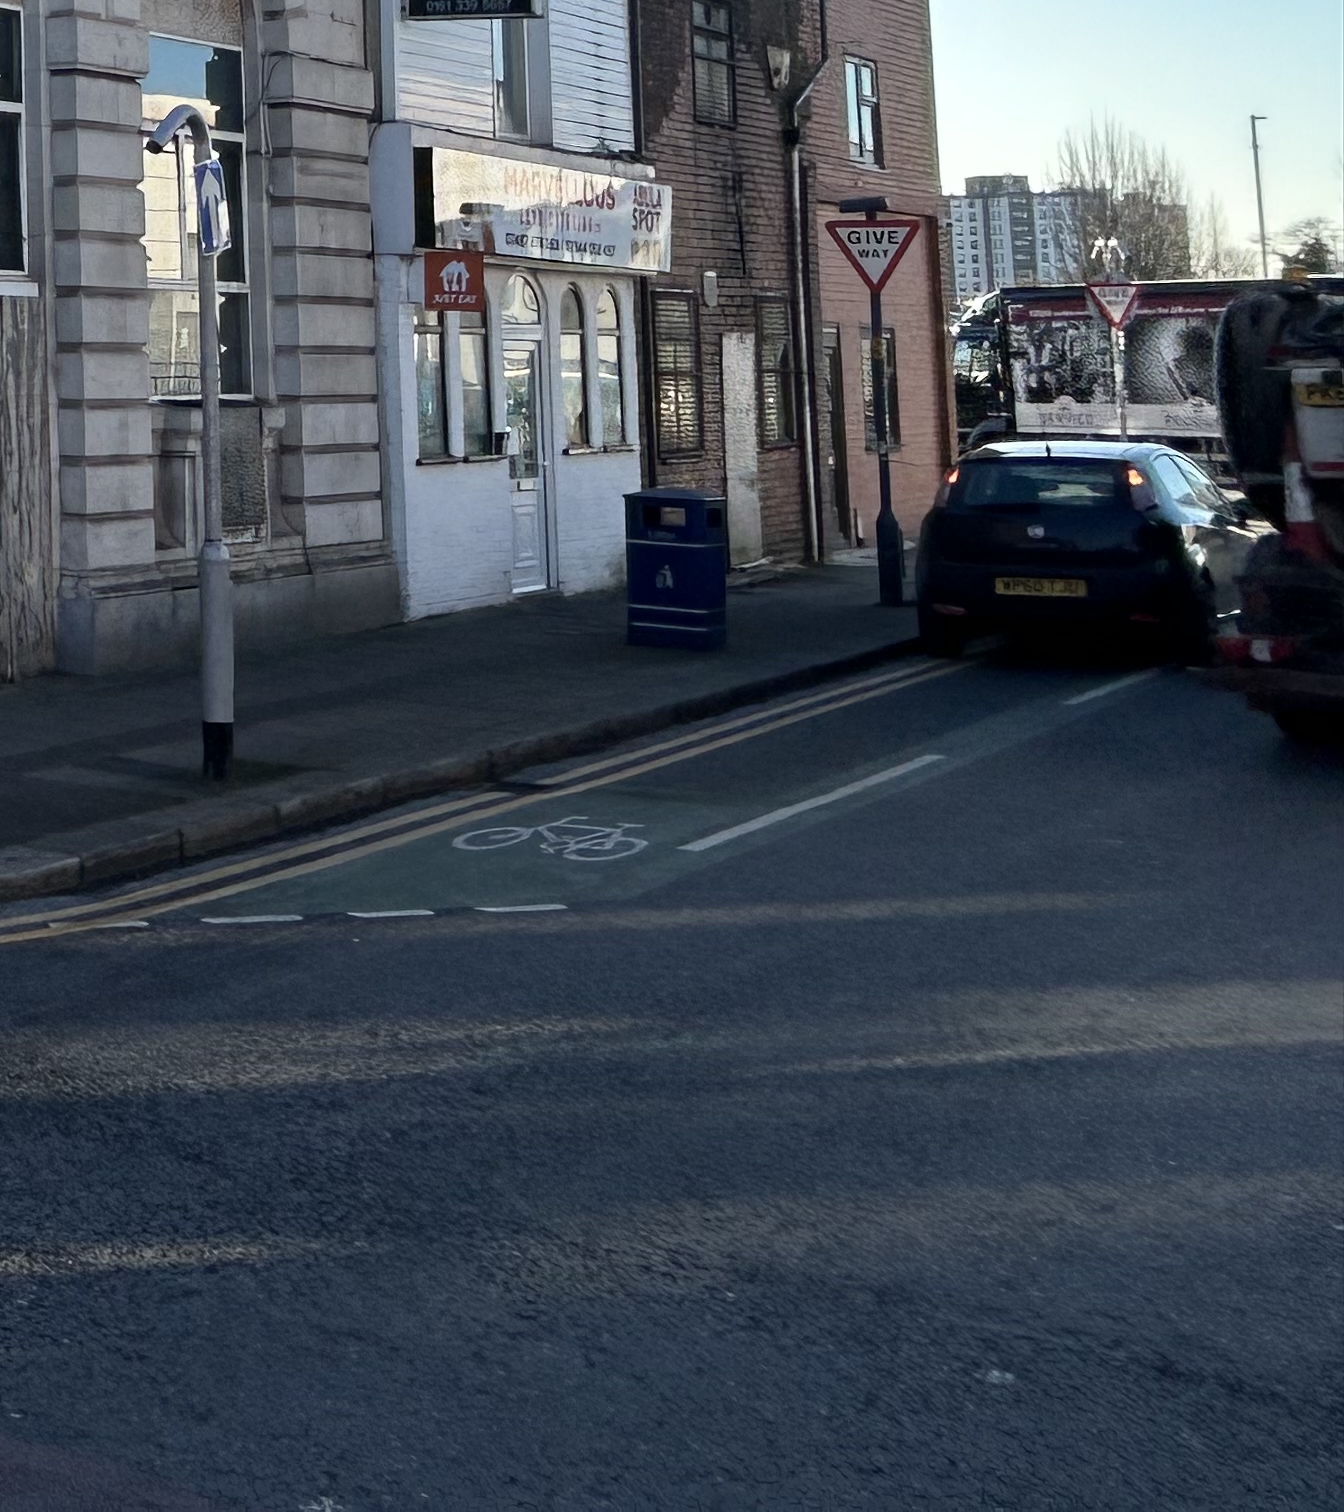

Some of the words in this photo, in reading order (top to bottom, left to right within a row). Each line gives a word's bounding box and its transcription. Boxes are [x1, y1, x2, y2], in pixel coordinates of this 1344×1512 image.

[631, 207, 662, 233] SPOT
[847, 230, 900, 245] GIVE
[857, 248, 889, 259] WAY
